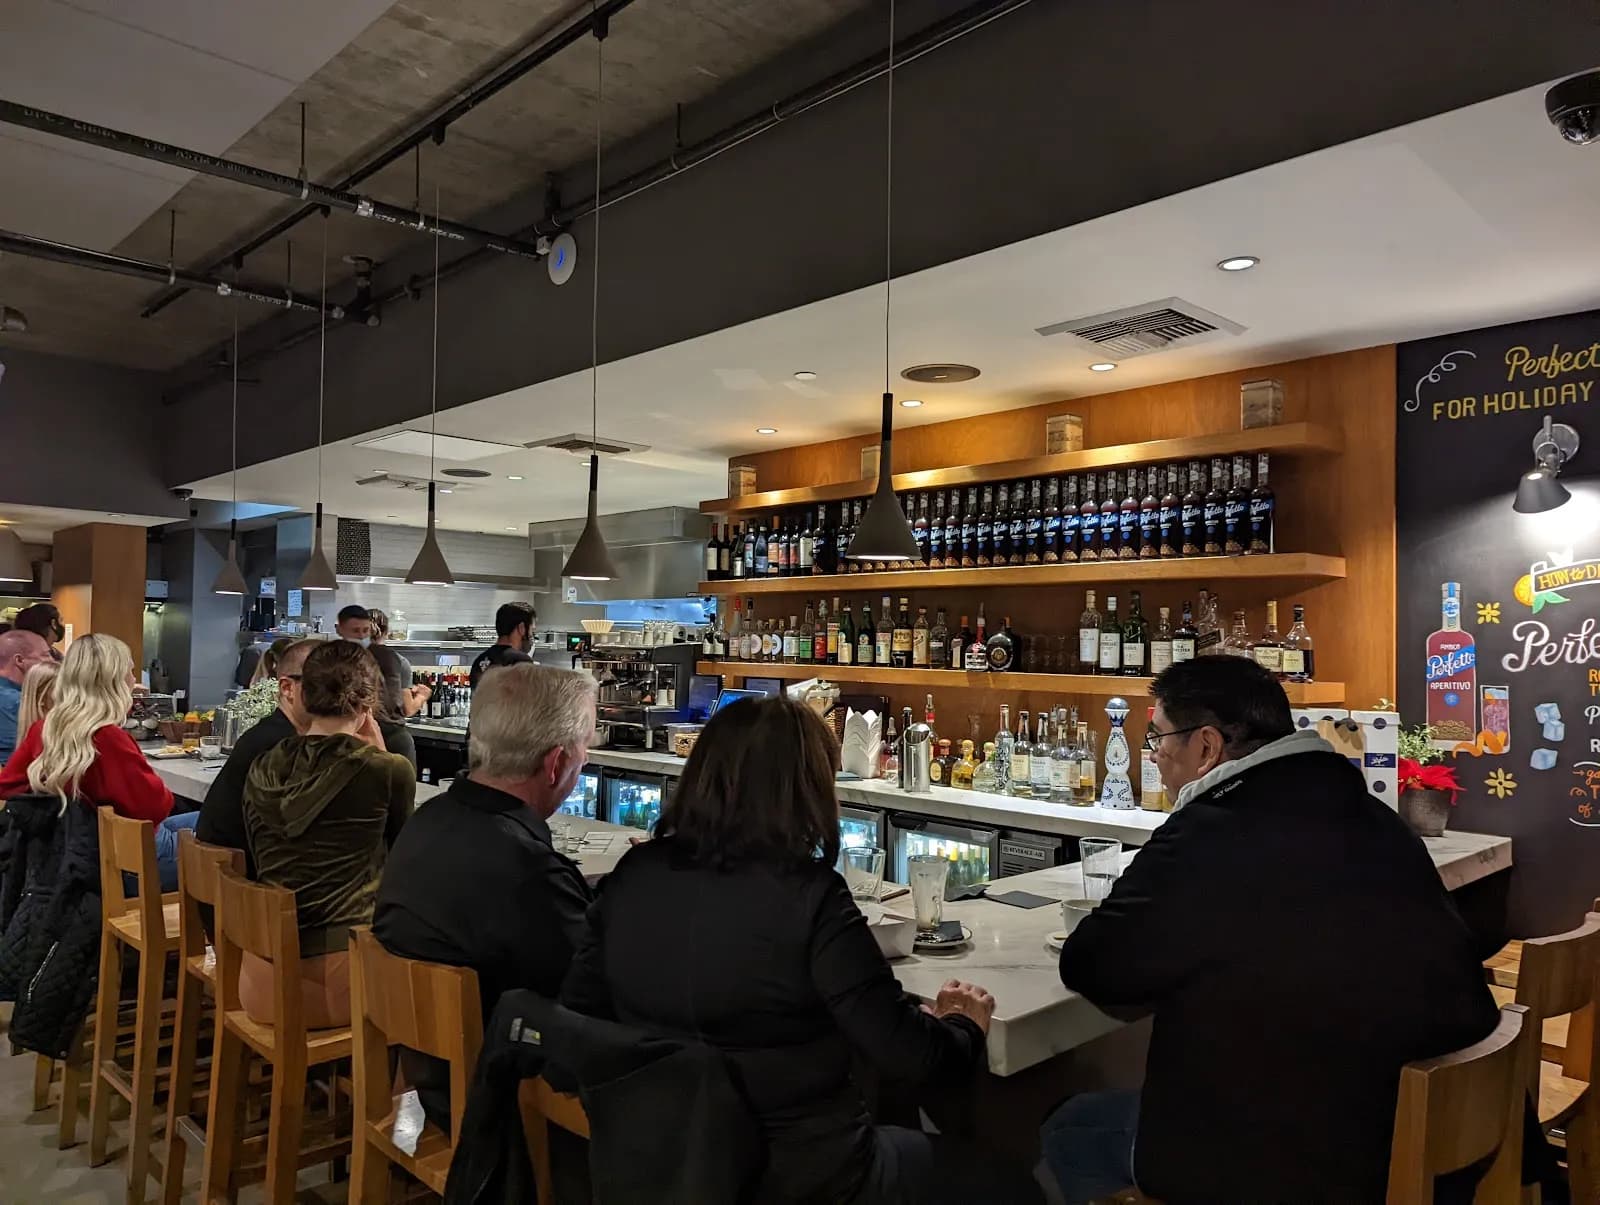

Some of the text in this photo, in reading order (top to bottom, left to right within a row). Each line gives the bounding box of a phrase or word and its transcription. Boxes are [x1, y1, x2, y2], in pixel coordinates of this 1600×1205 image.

[1505, 343, 1600, 381] Perfect
[1433, 381, 1594, 420] FOR HOLIDAY
[1538, 569, 1570, 590] HOW
[1427, 652, 1476, 679] Perfetto
[1430, 681, 1471, 690] APERITIVO
